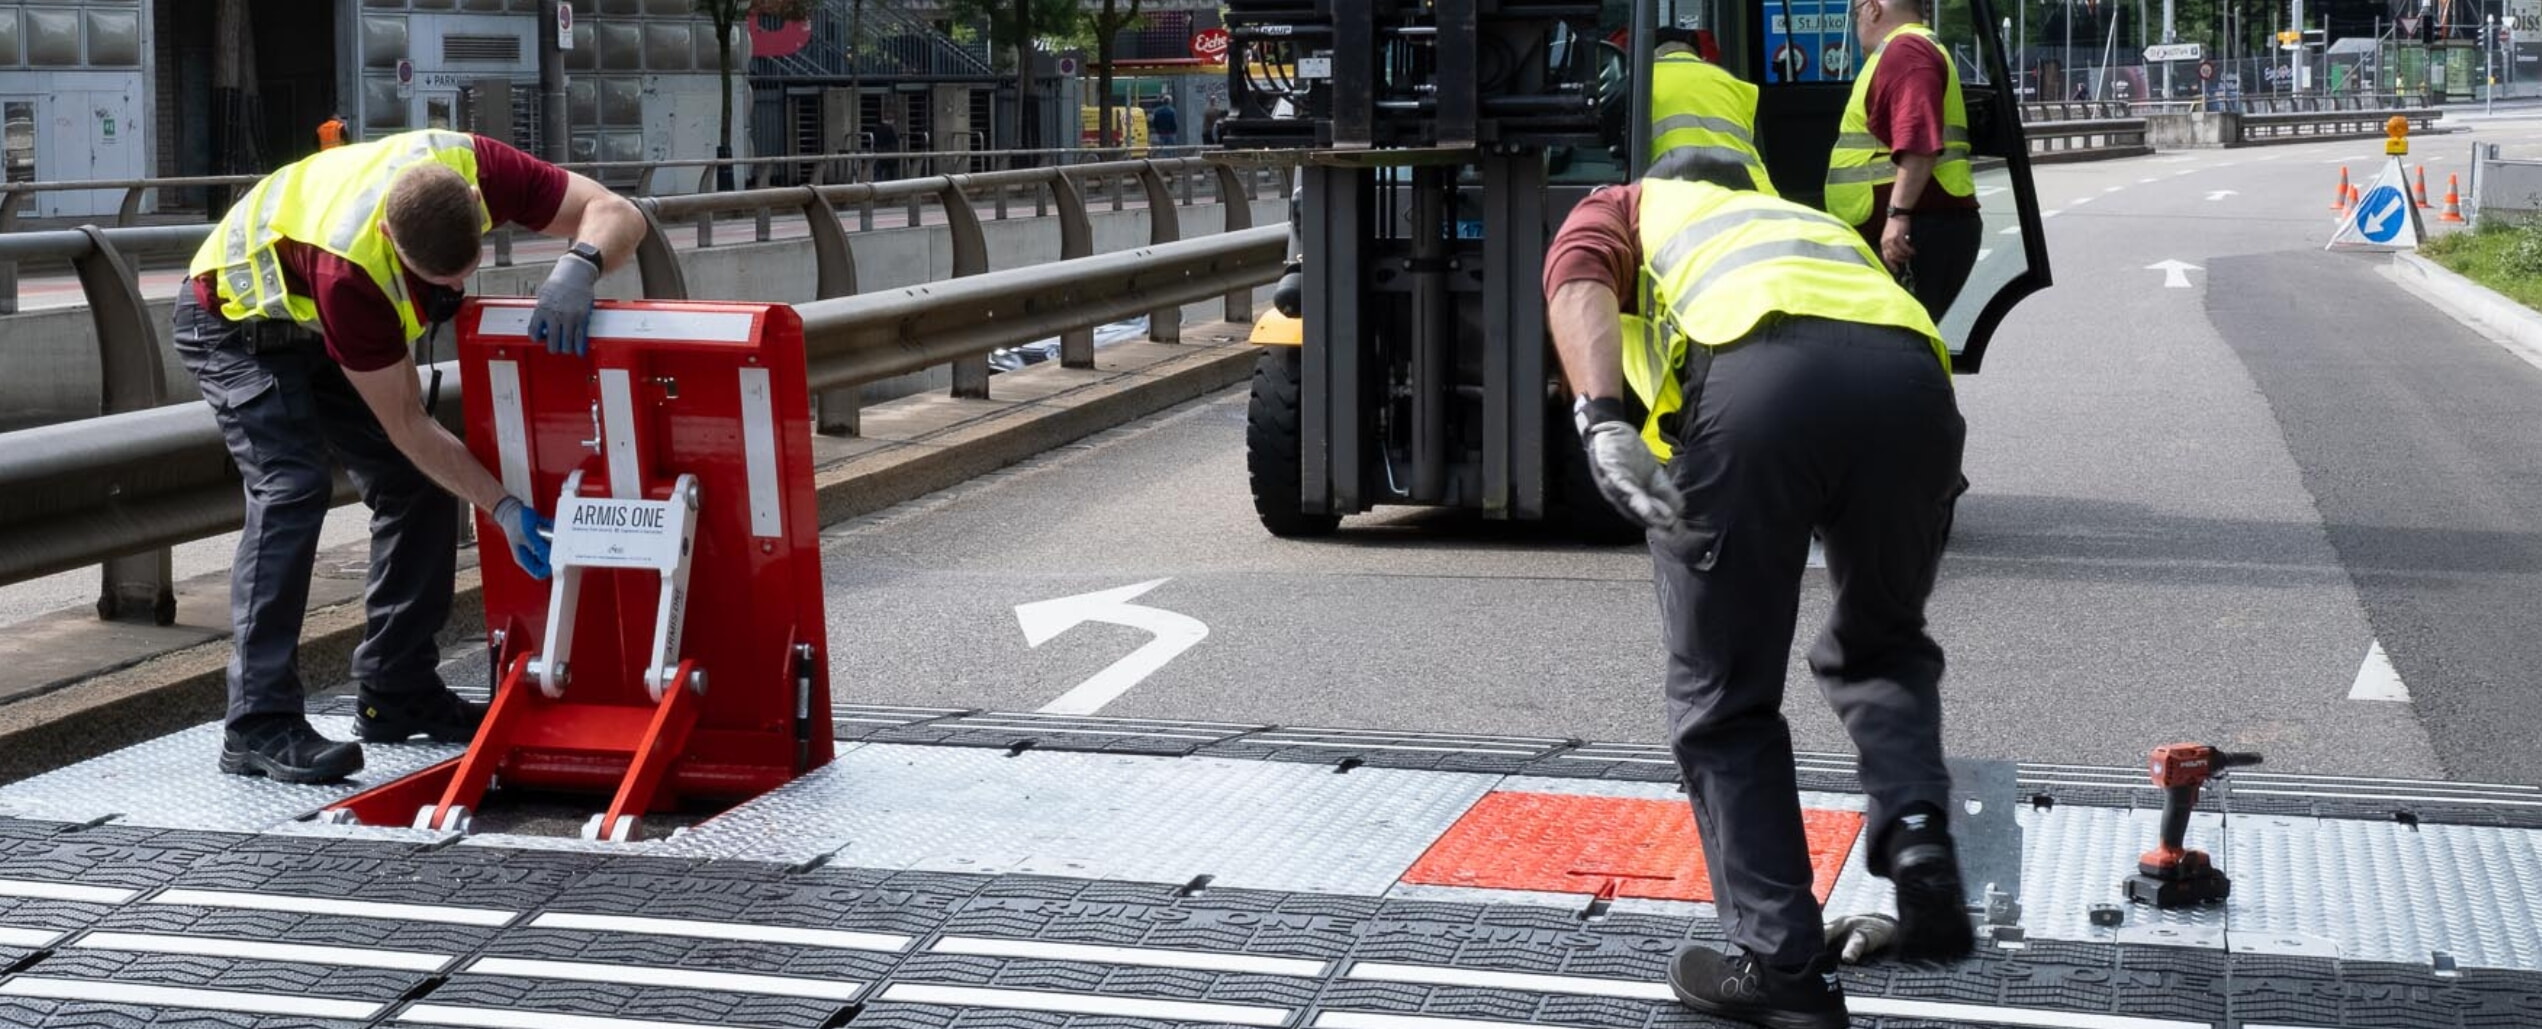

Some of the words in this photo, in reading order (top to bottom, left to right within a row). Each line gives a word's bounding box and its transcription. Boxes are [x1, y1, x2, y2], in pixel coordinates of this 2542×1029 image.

[572, 504, 627, 527] ARMIS
[631, 507, 666, 528] ONE
[75, 845, 206, 867] ONE
[202, 851, 421, 876] ARMIS
[573, 872, 797, 899] ARMIS
[817, 888, 956, 910] ONE
[961, 897, 1192, 922] ARMIS
[1216, 912, 1358, 933] ONE
[1364, 921, 1602, 951] ARMIS
